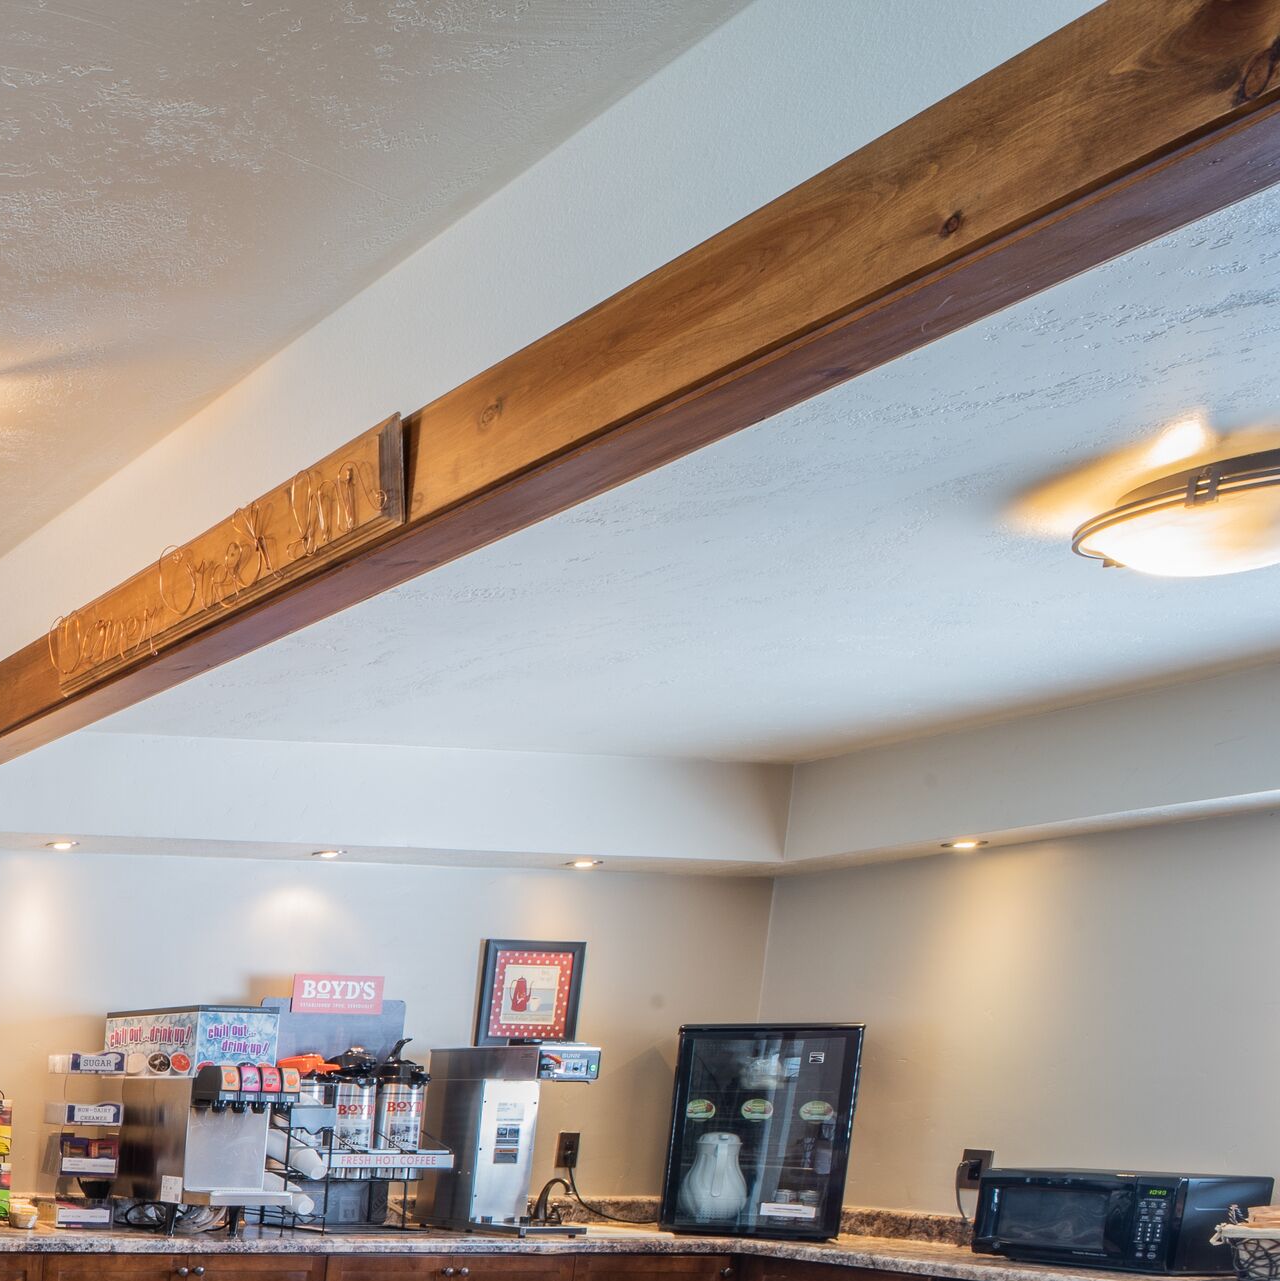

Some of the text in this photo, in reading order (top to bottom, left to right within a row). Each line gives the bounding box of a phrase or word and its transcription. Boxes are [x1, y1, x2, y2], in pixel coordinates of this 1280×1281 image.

[302, 980, 376, 1000] BOYD'S
[110, 1027, 127, 1047] chill
[174, 1025, 192, 1046] up!
[208, 1024, 229, 1038] chill
[221, 1040, 269, 1055] drink up!
[83, 1059, 112, 1067] SUGAR
[341, 1156, 437, 1165] FRESH HOT COFFEE
